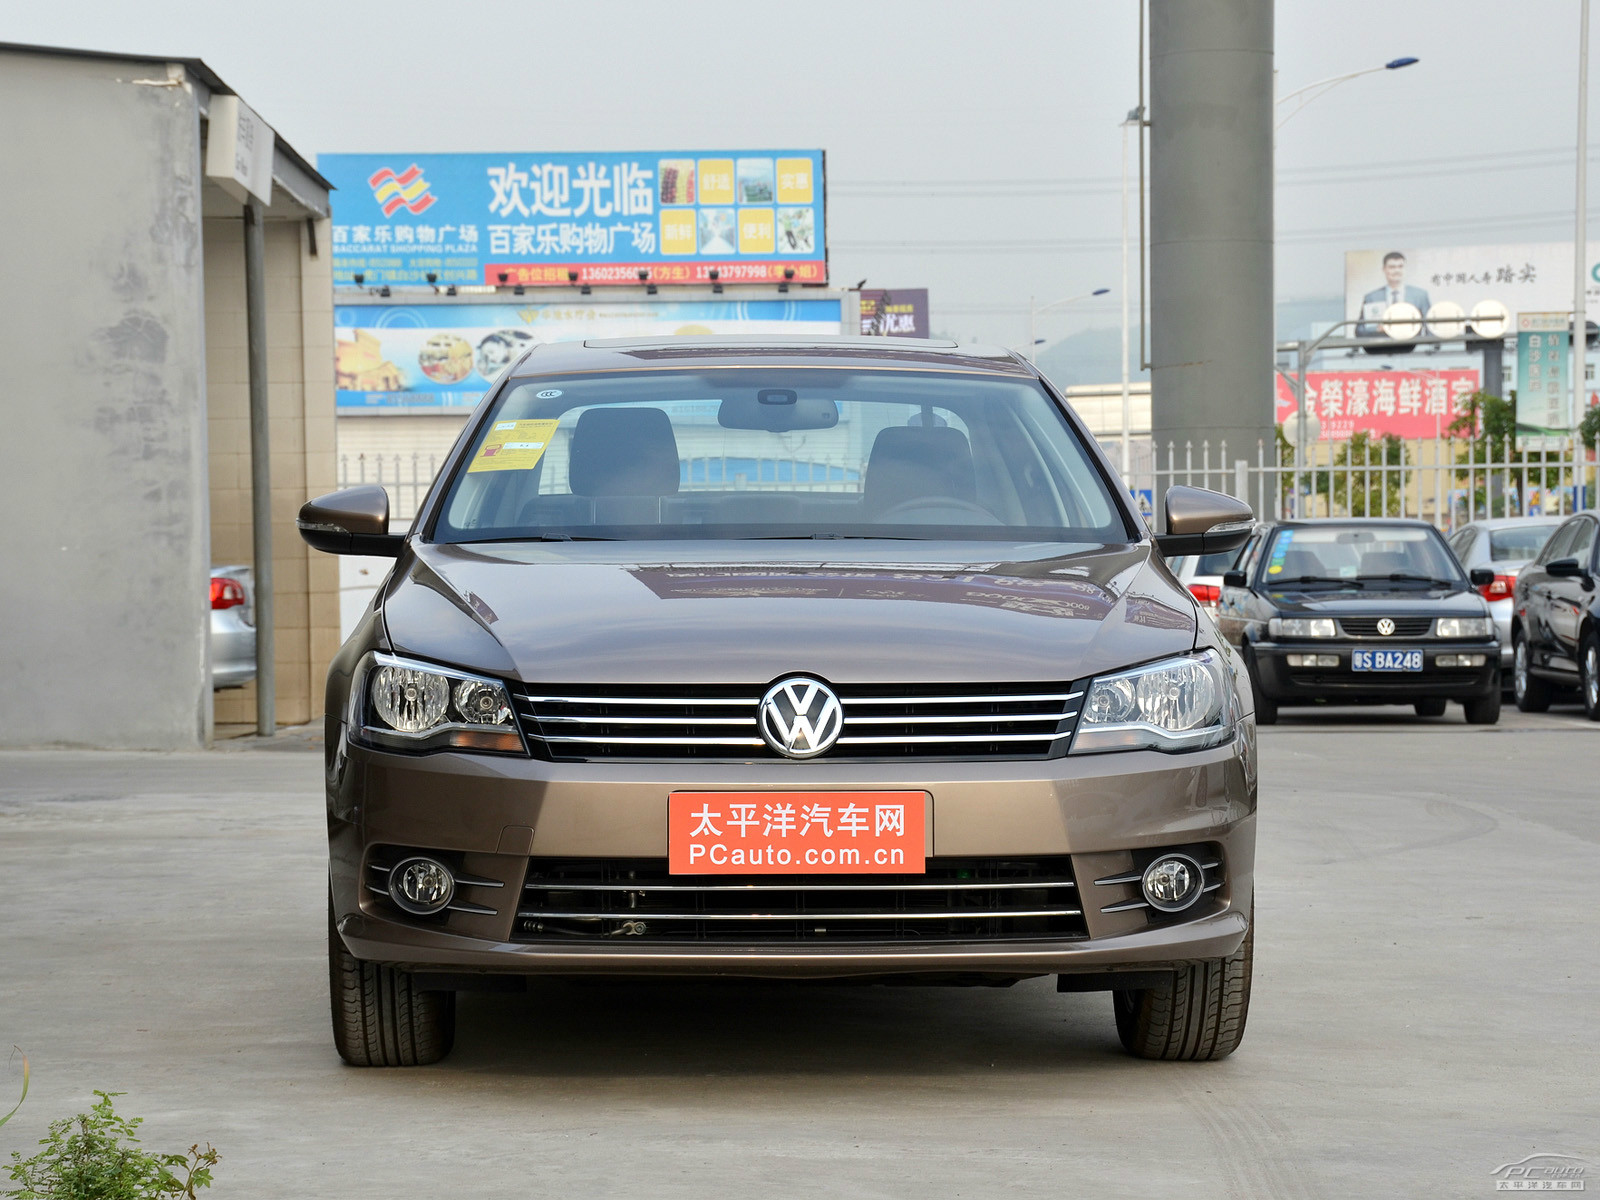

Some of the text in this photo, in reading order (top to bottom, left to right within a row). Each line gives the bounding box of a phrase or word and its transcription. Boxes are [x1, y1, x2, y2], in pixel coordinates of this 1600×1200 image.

[487, 162, 654, 218] 欢迎光临
[333, 225, 479, 244] 百家乐购物广场
[487, 223, 655, 256] 百家乐购物广场
[445, 244, 478, 253] PLAZA
[1375, 652, 1422, 669] BA248
[690, 803, 905, 837] 太平洋汽车网
[689, 844, 905, 865] PCauto.com.cn
